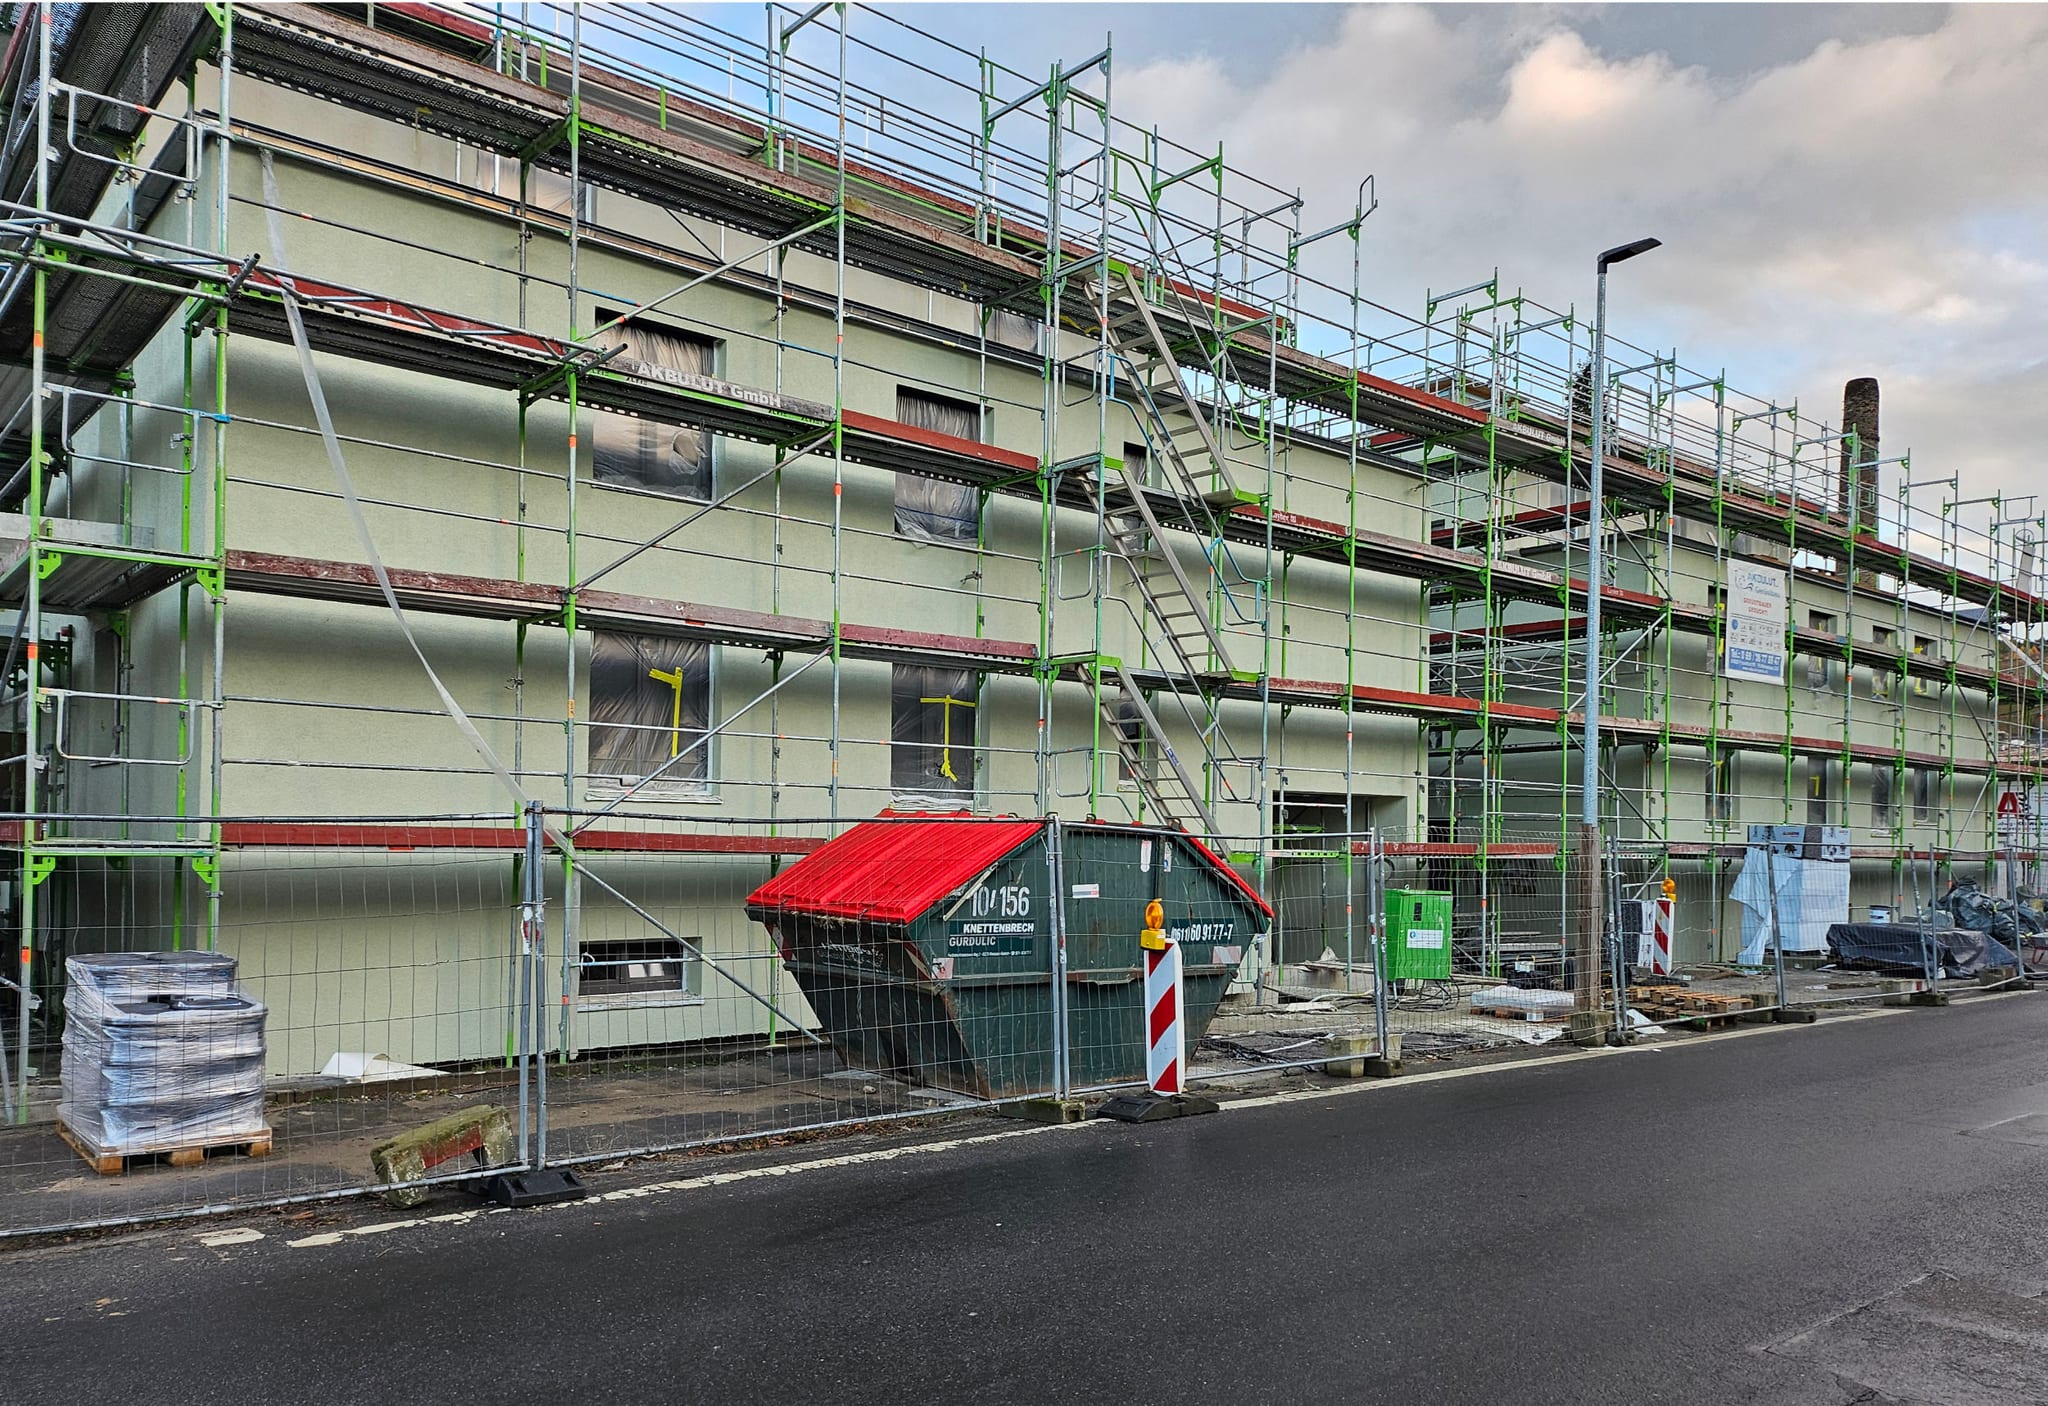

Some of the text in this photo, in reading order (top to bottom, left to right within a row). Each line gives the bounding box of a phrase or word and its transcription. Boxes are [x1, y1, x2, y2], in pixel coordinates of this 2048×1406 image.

[637, 361, 782, 408] AKBULUT GmbH
[963, 922, 1034, 934] KNETTENBRECH
[949, 936, 996, 947] GURDULIC
